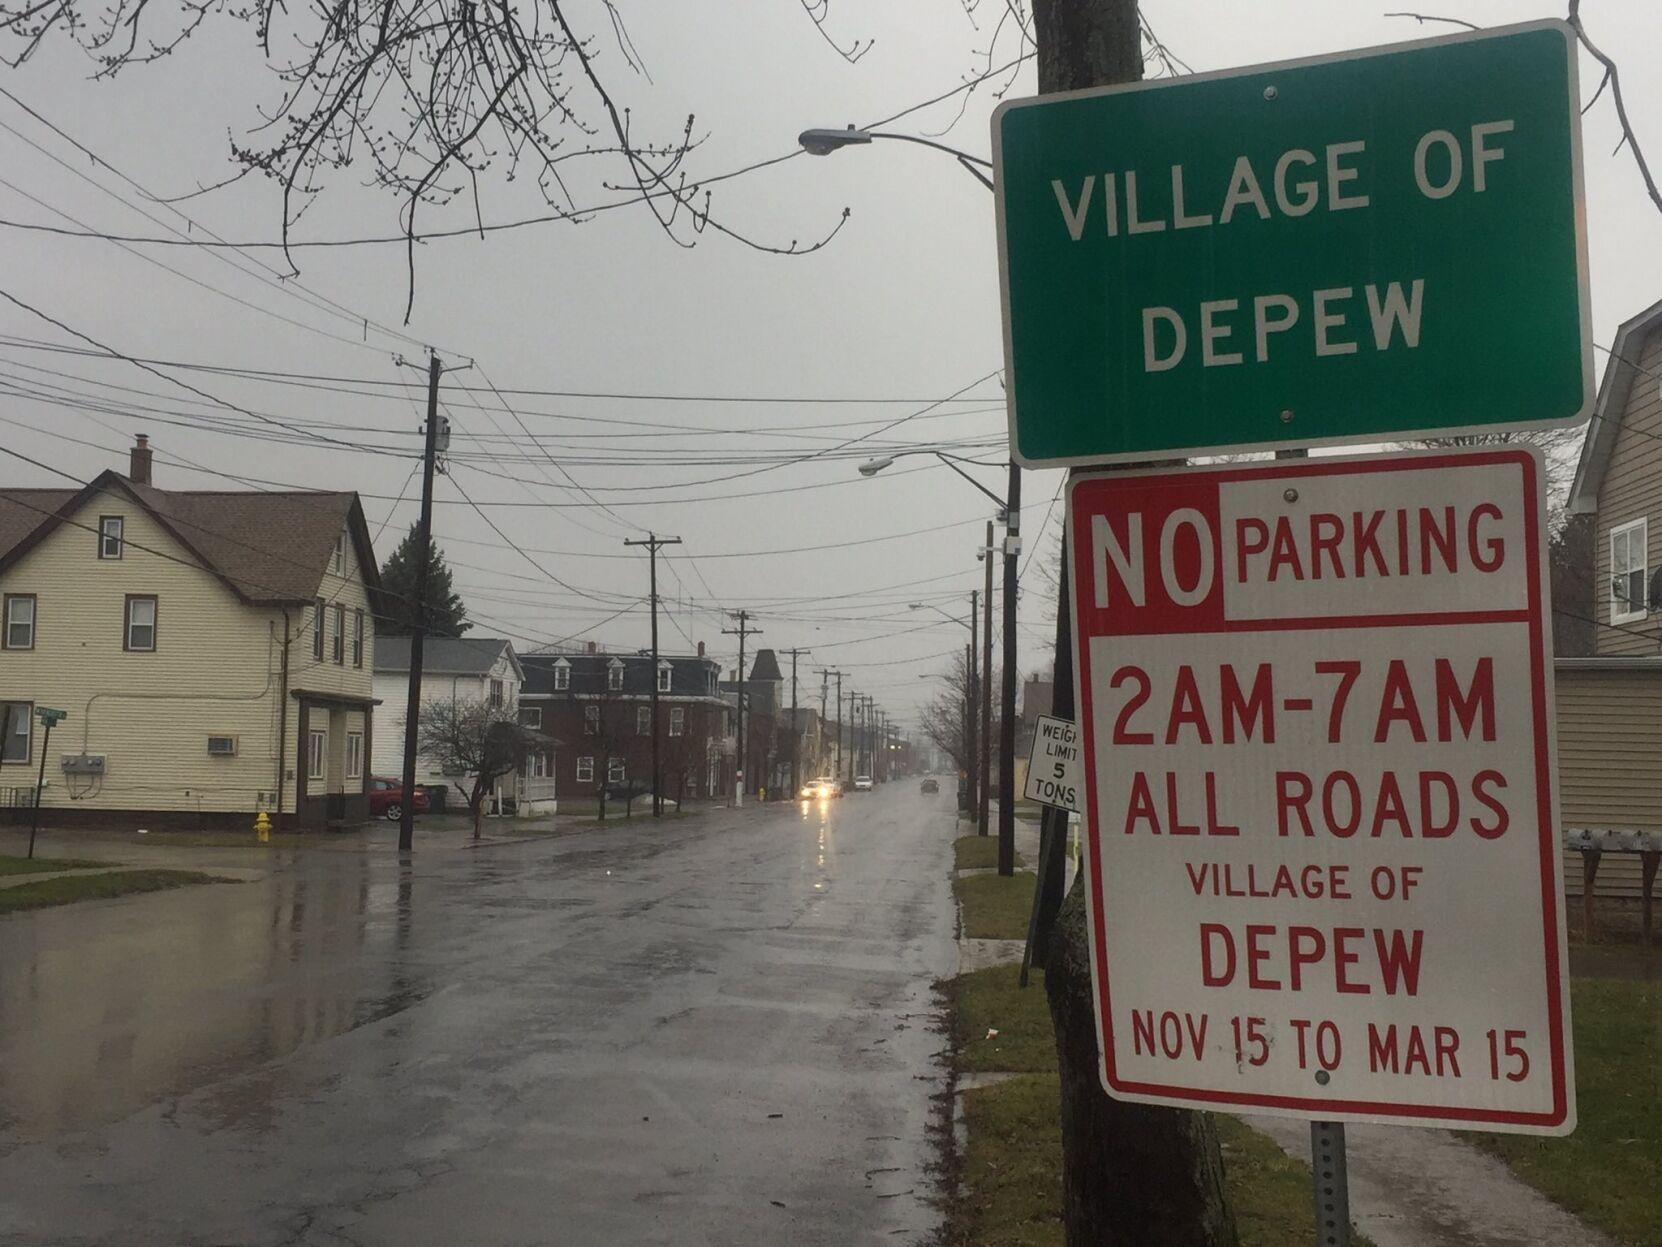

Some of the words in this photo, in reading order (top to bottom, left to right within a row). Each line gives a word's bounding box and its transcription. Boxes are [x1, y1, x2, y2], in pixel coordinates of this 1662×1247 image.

[1052, 140, 1370, 241] VILLAGE
[1414, 120, 1515, 199] OF
[1142, 279, 1425, 373] DEPEW
[1091, 507, 1216, 609] NO
[1236, 503, 1505, 584] PARKING
[1110, 657, 1498, 745] 2AM-7AM
[1036, 779, 1076, 803] TONS
[1053, 762, 1065, 779] 5
[1124, 771, 1240, 836] ALL
[1275, 769, 1510, 840] ROADS
[1185, 862, 1352, 899] VILLAGE
[1371, 866, 1424, 901] OF
[1200, 923, 1425, 996] DEPEW
[1131, 1009, 1208, 1062] NOV
[1230, 1016, 1270, 1068] 15
[1289, 1019, 1343, 1072] TO
[1367, 1023, 1462, 1078] MAR
[1486, 1029, 1531, 1082] 15
